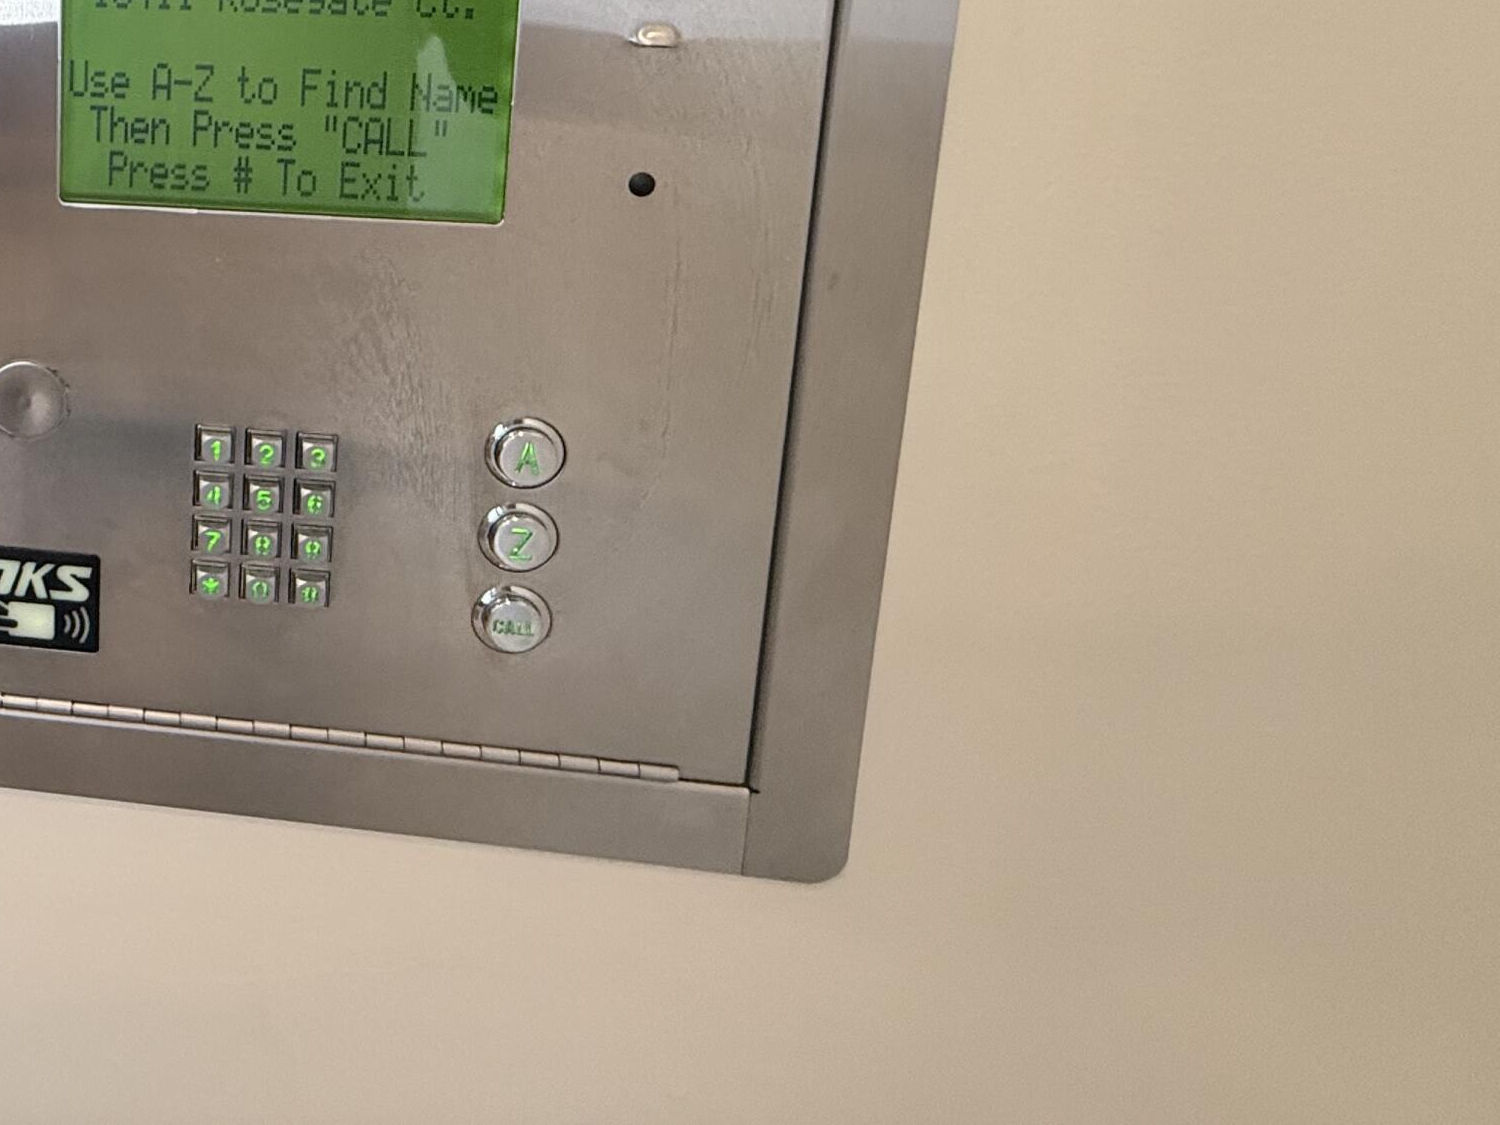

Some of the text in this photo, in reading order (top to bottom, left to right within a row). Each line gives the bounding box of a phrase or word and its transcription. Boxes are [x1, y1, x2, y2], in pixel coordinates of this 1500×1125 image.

[69, 60, 498, 115] Use A-Z to Find Name
[89, 105, 170, 146] Then
[193, 109, 297, 151] Press
[108, 151, 210, 191] Press
[277, 158, 316, 196] To
[339, 162, 425, 202] Exit
[210, 440, 221, 461] 1
[258, 445, 274, 466] 2
[515, 442, 540, 474] A
[256, 490, 271, 510] 5
[205, 531, 221, 551] 7
[509, 528, 533, 561] Z
